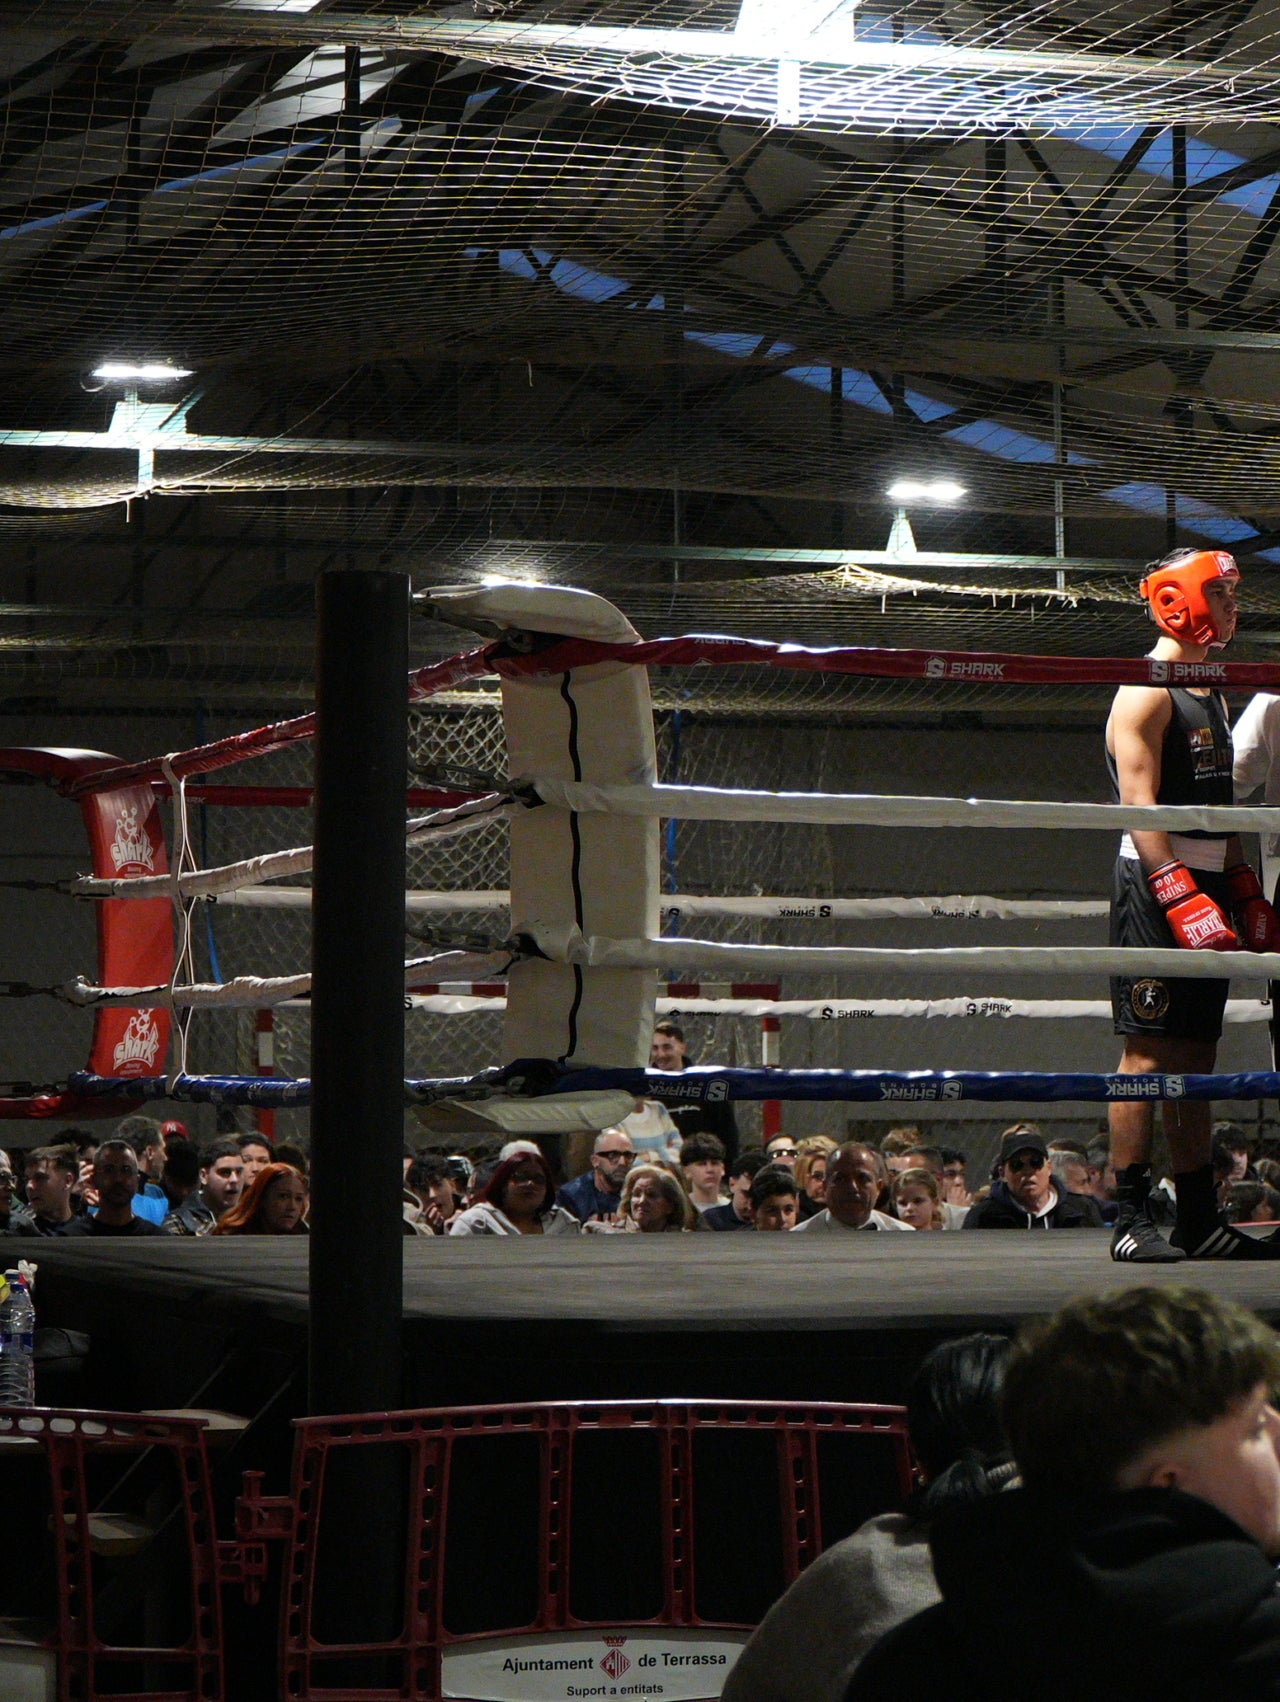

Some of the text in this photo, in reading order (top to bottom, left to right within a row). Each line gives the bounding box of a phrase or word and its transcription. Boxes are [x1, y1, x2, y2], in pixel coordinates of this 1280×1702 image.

[950, 663, 1005, 675] SHARK
[1174, 664, 1227, 677] SHARK
[1164, 872, 1175, 885] 10
[779, 908, 816, 917] SHARK
[837, 1009, 876, 1019] SHARK
[981, 1002, 1013, 1014] SHARK
[648, 1086, 702, 1097] SHARK
[880, 1087, 938, 1099] SHARK
[1105, 1083, 1160, 1096] SHARK
[502, 1652, 727, 1675] Ajuntament de Terrassa
[566, 1684, 664, 1699] Suport a entitats
